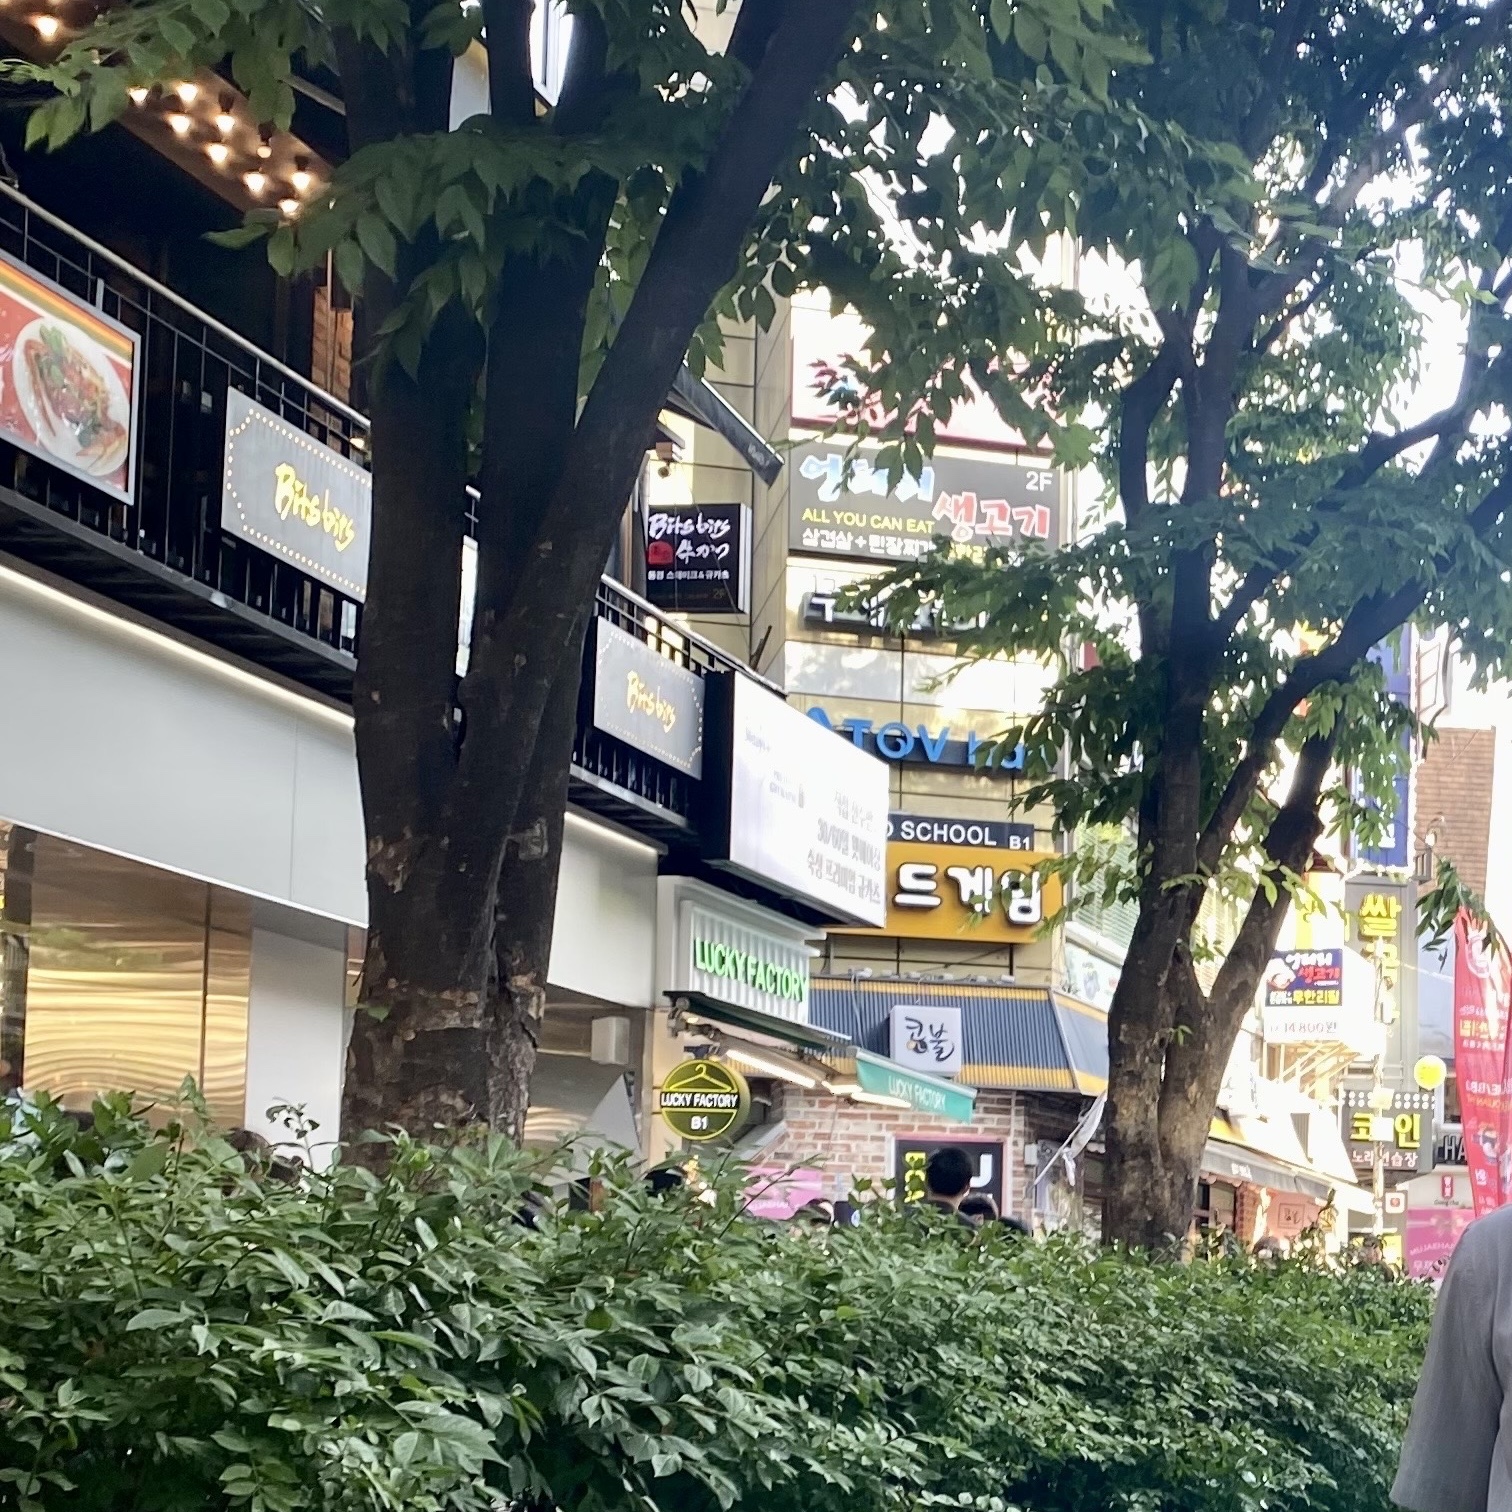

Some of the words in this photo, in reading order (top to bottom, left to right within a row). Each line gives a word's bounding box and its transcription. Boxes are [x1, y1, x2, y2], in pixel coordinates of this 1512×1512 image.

[1026, 471, 1052, 492] 2F
[649, 513, 694, 539] Bits
[802, 508, 830, 524] ALL
[833, 510, 867, 527] YOU
[870, 515, 903, 532] CAN
[906, 518, 936, 535] EAT
[932, 491, 1050, 542] 생고기
[900, 820, 997, 847] SCHOOL
[1009, 835, 1031, 850] B1
[695, 936, 747, 982] LUCKY
[746, 954, 808, 1003] FACTORY
[661, 1092, 692, 1107] LUCKY
[693, 1093, 738, 1108] FACTORY
[888, 1075, 914, 1101] LUCKY
[914, 1084, 946, 1112] FACTORY
[691, 1116, 708, 1130] B1
